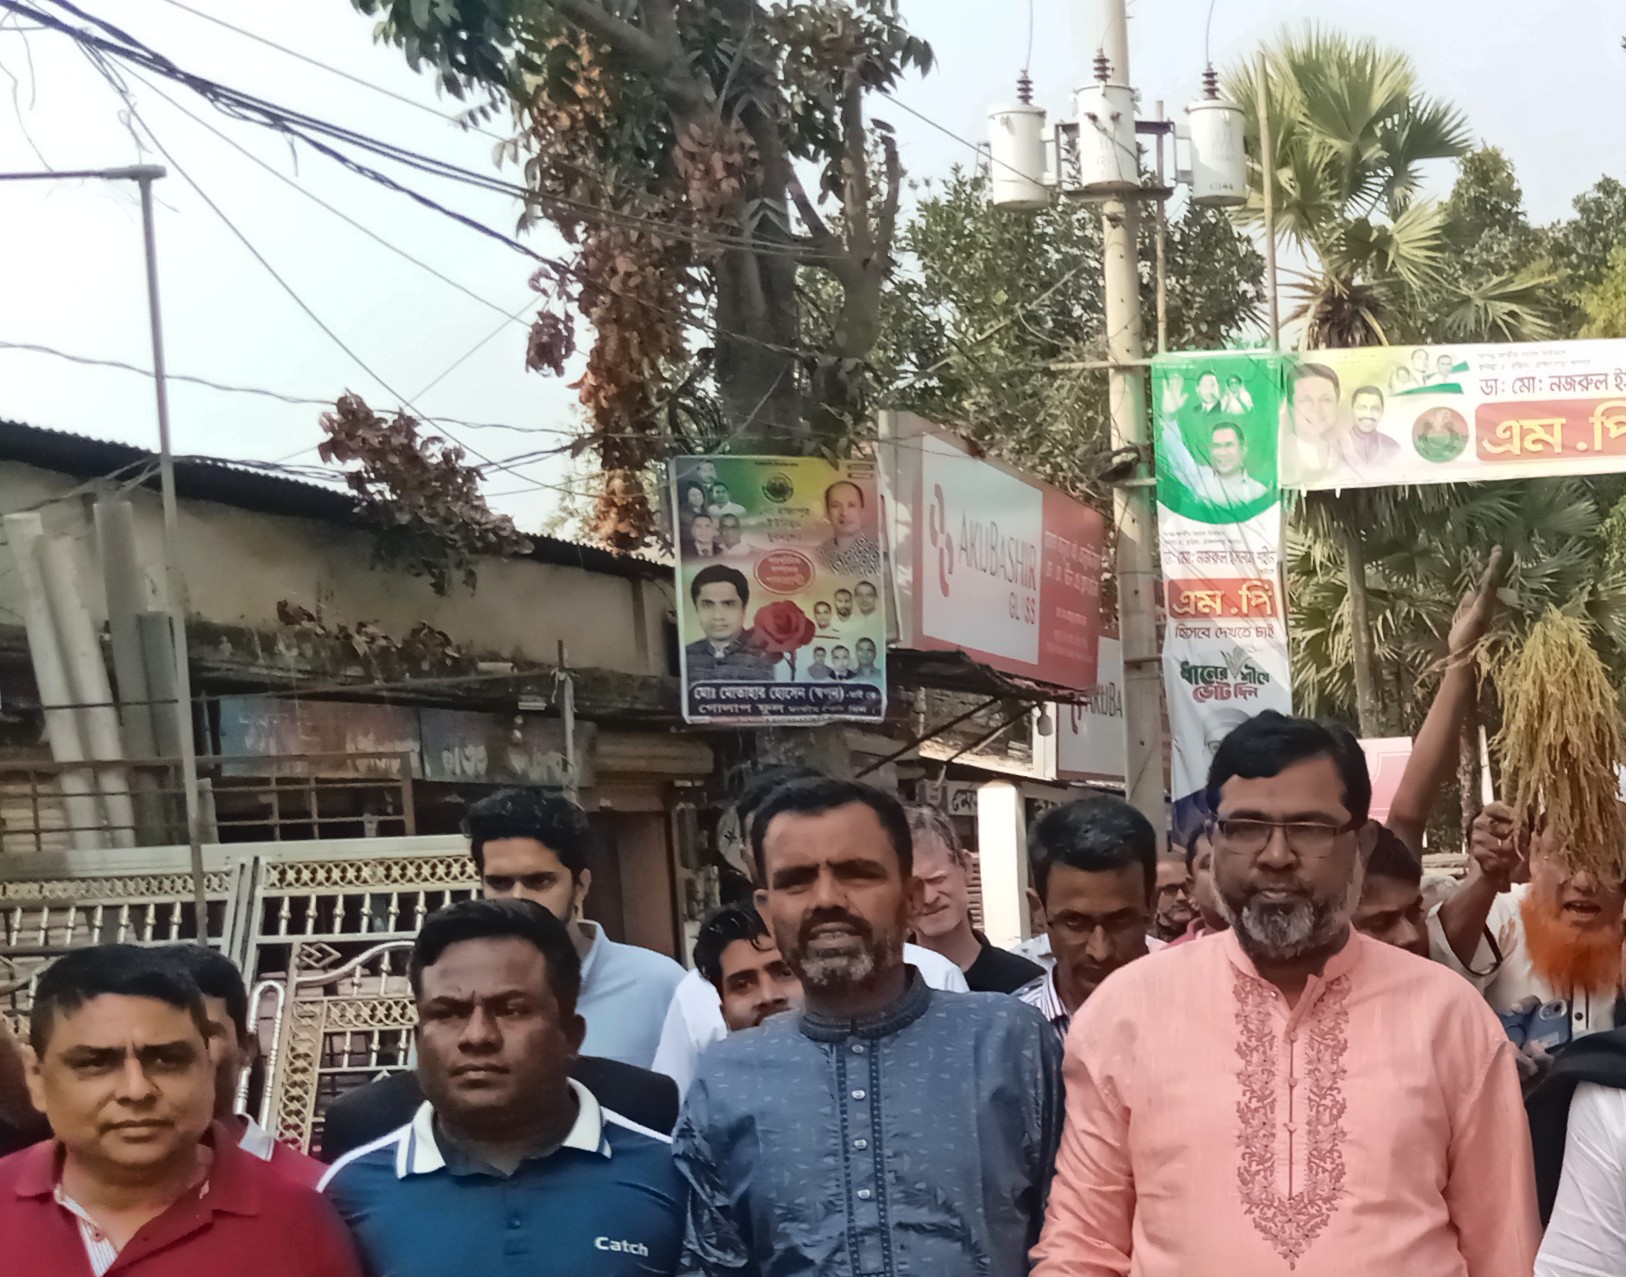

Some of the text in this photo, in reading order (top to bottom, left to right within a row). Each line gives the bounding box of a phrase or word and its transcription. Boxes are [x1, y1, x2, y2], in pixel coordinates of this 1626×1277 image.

[1548, 372, 1608, 394] নজরুল
[1008, 591, 1036, 625] GLSS
[1175, 624, 1275, 640] হিসেবে দেখতে চাই
[1180, 660, 1270, 686] ধানের শীষে
[1192, 681, 1259, 703] ভোট দিন
[594, 1236, 649, 1257] Catch
